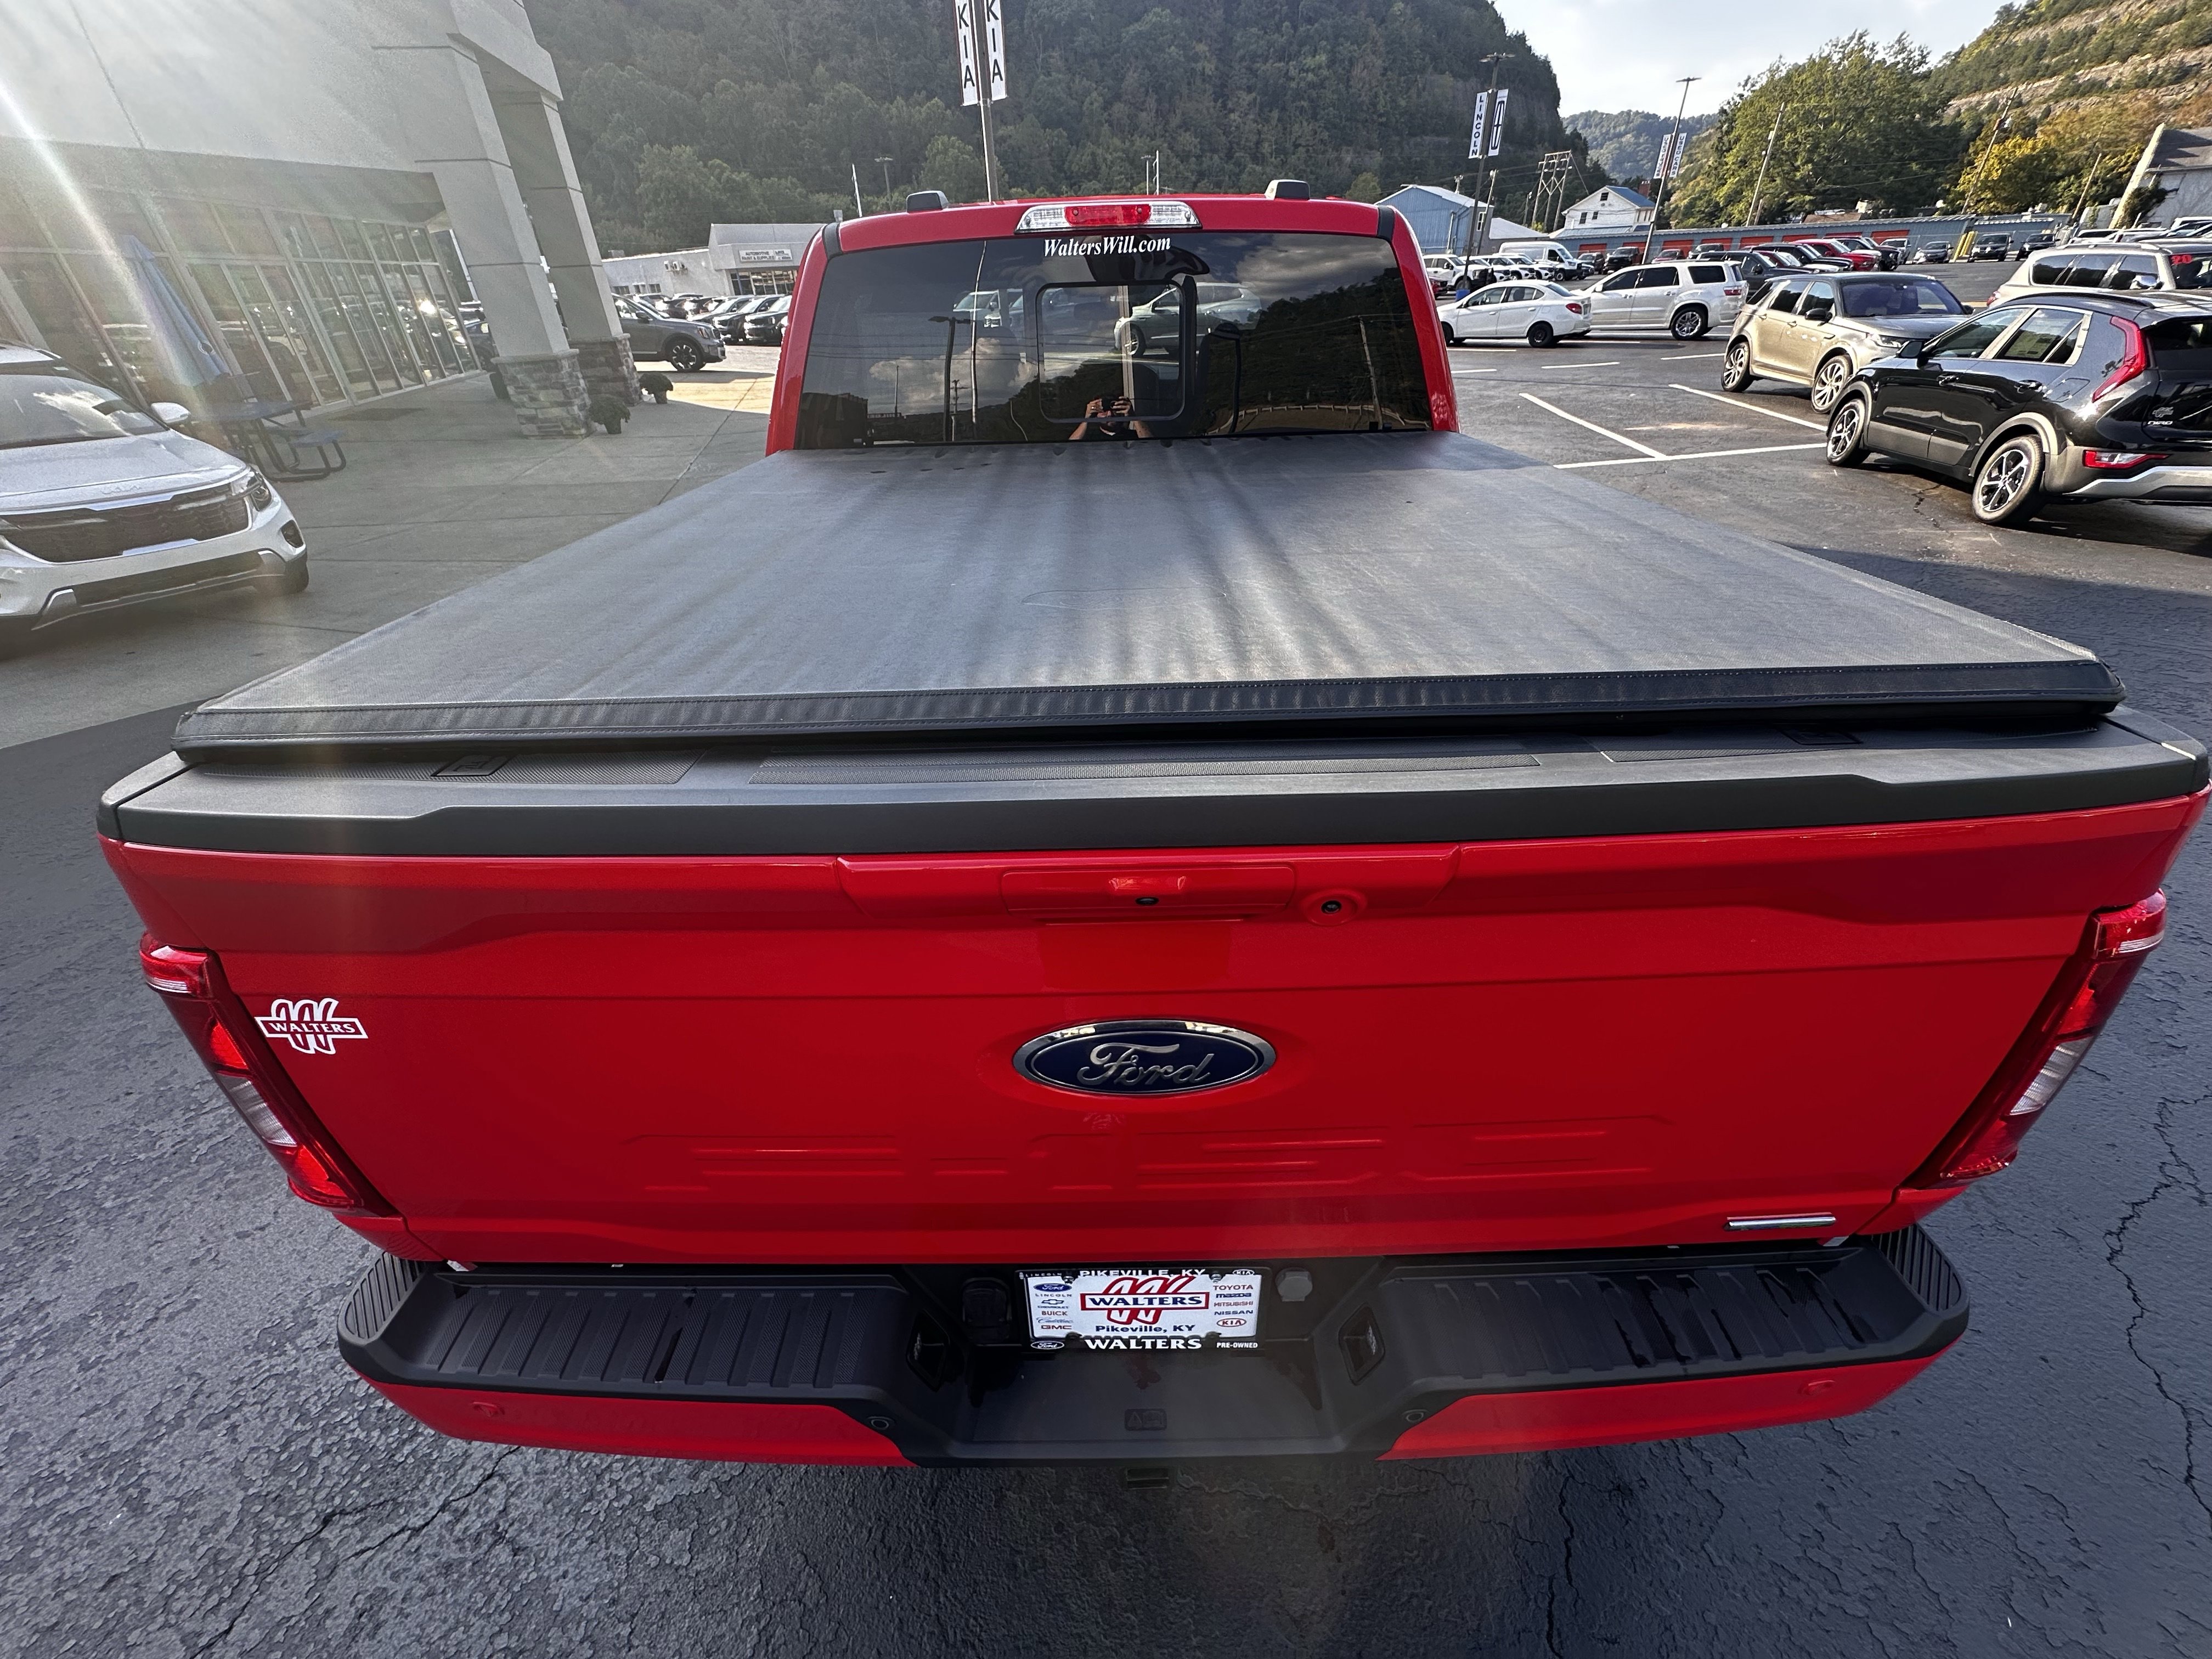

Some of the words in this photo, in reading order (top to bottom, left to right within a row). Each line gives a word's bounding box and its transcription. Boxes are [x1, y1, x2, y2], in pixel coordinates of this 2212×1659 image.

[958, 3, 975, 88] KIA
[986, 0, 1003, 83] KIA
[1471, 95, 1483, 156] LINCOLN
[1676, 136, 1684, 155] USED
[1044, 235, 1171, 257] WaltersWill.com
[268, 1023, 356, 1033] WALTERS
[1077, 1042, 1215, 1086] Ford
[1088, 1296, 1203, 1306] WALTERS
[1095, 1325, 1167, 1333] Pikeville,
[1084, 1339, 1202, 1349] WALTERS
